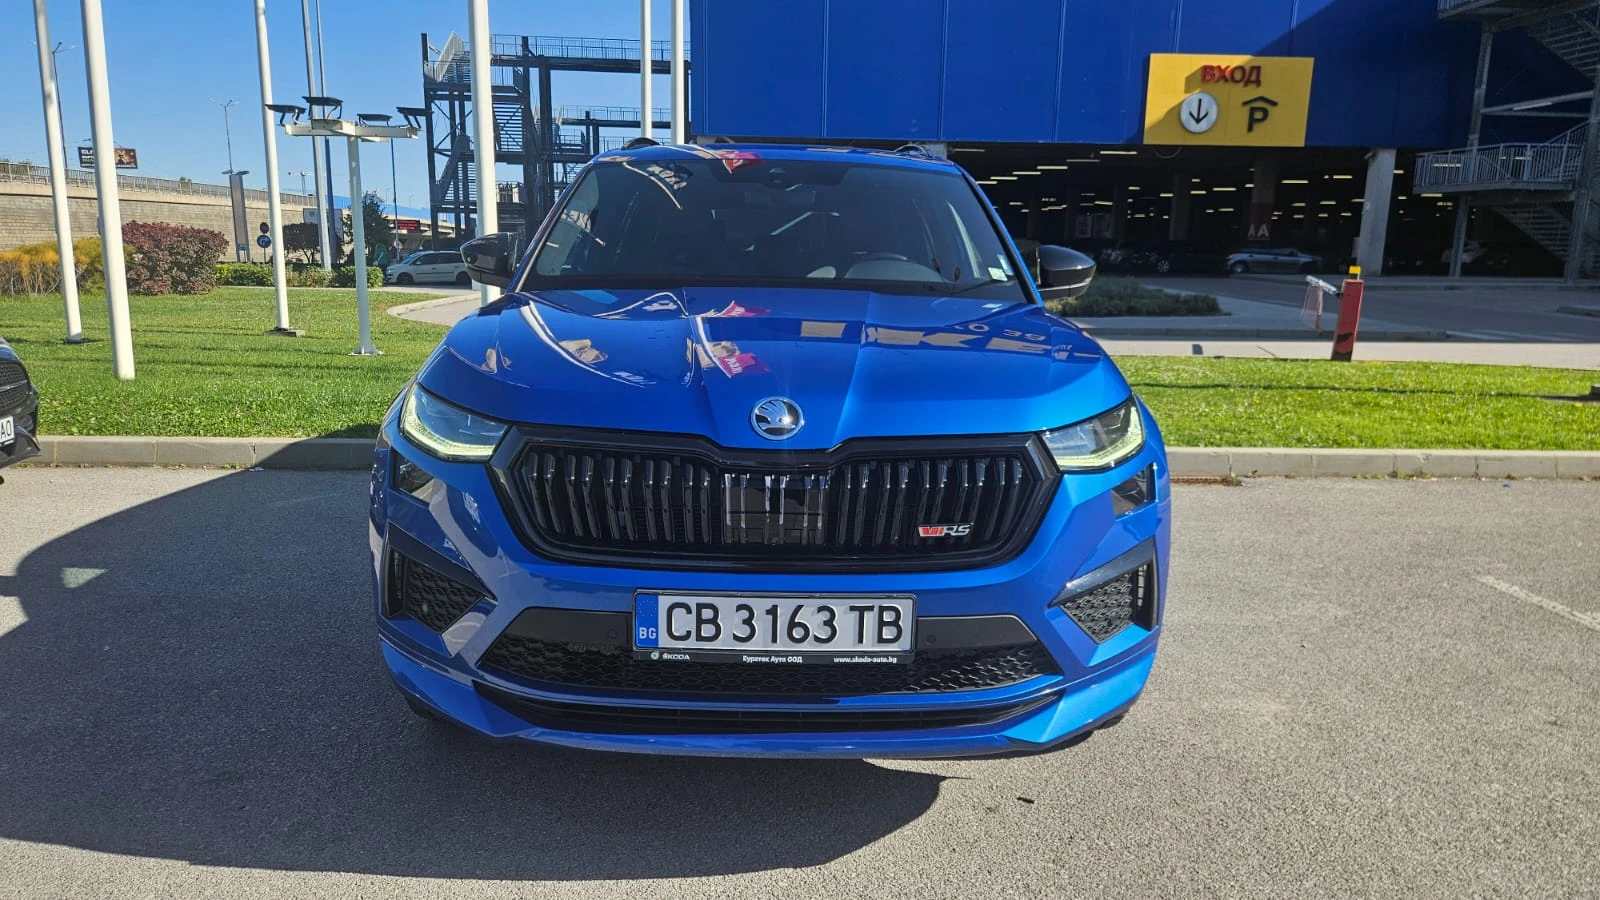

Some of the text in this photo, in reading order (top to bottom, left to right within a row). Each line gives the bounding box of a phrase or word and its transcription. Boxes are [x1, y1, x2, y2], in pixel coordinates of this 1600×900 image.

[1201, 64, 1262, 88] ВХОД
[1247, 106, 1269, 133] P
[639, 627, 657, 639] BG
[666, 602, 903, 644] CB 3163 TB
